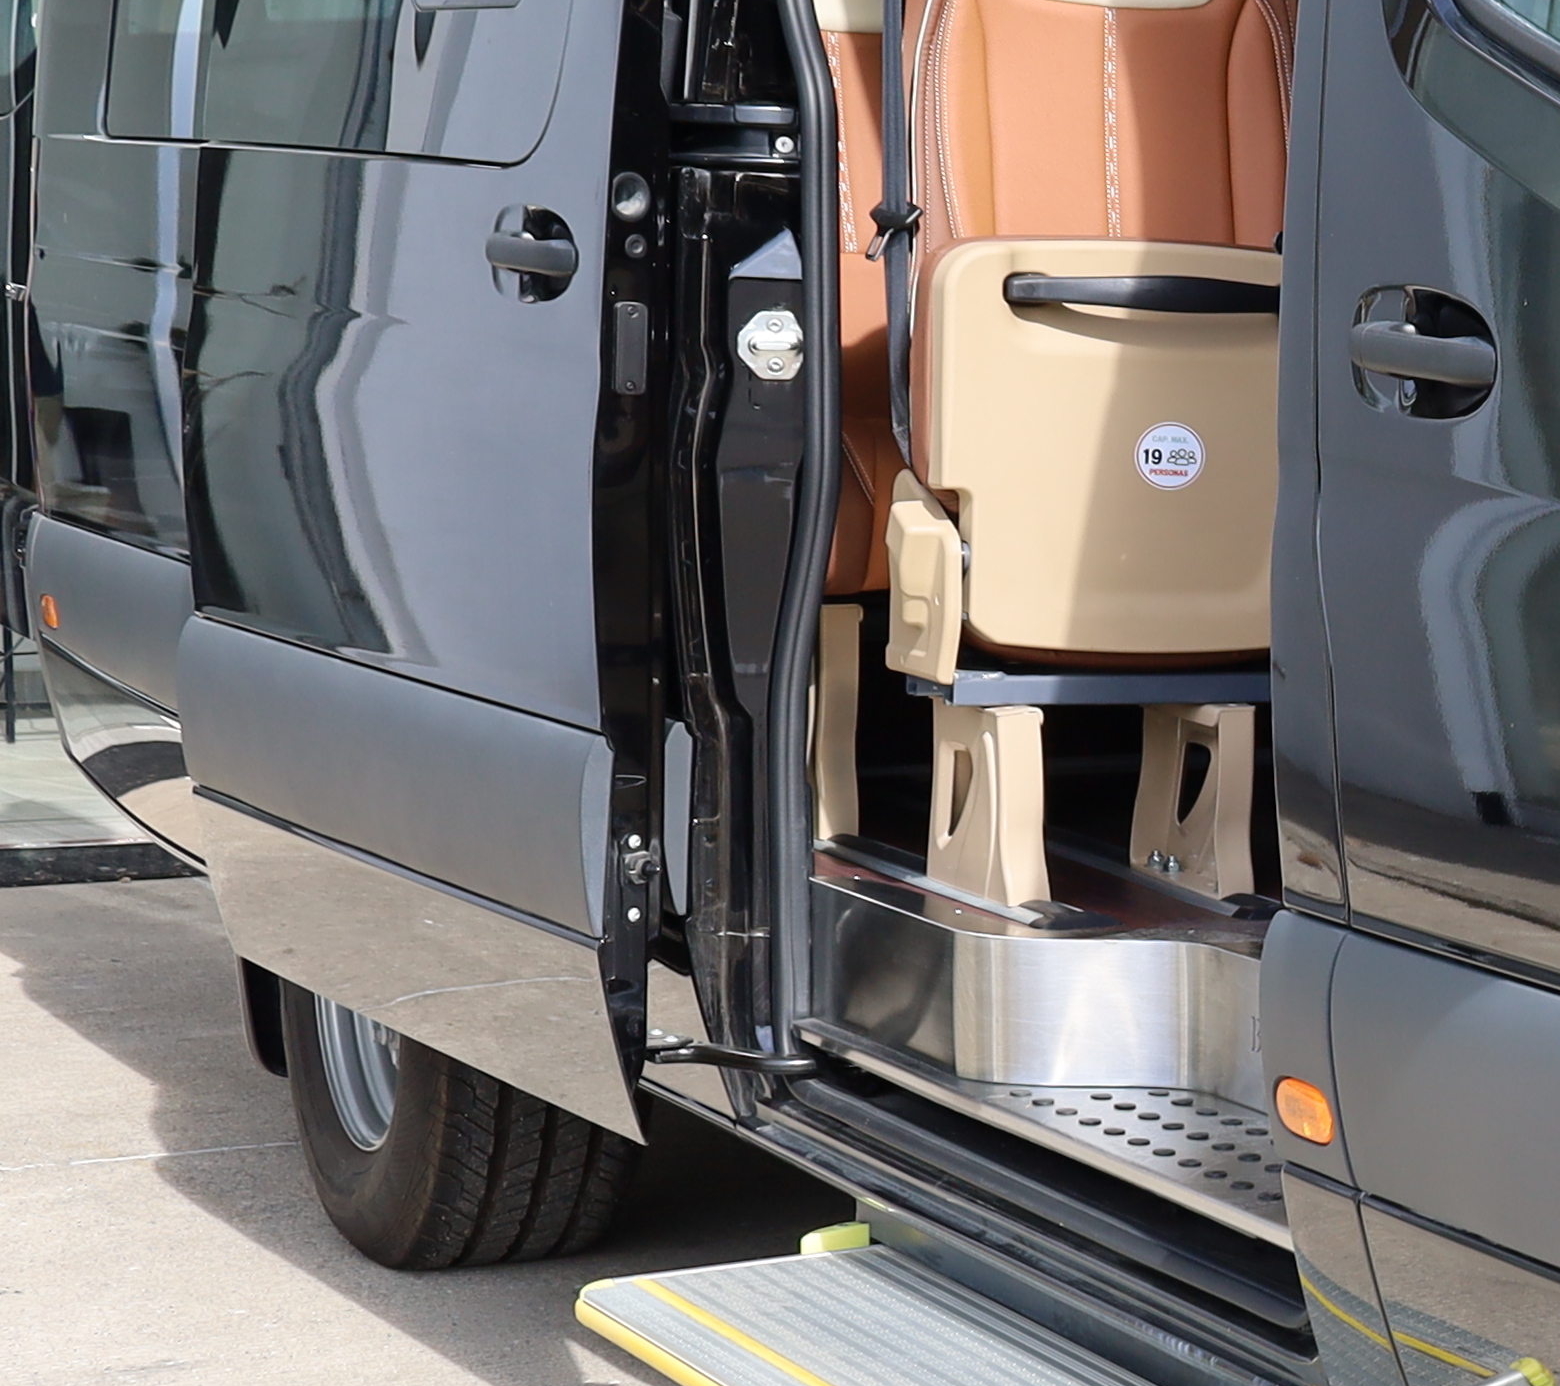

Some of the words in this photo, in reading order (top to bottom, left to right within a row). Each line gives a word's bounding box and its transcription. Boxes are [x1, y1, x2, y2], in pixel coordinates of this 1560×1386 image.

[1152, 435, 1171, 443] CAP.
[1143, 448, 1162, 465] 19
[1149, 468, 1188, 477] PERSONAS
